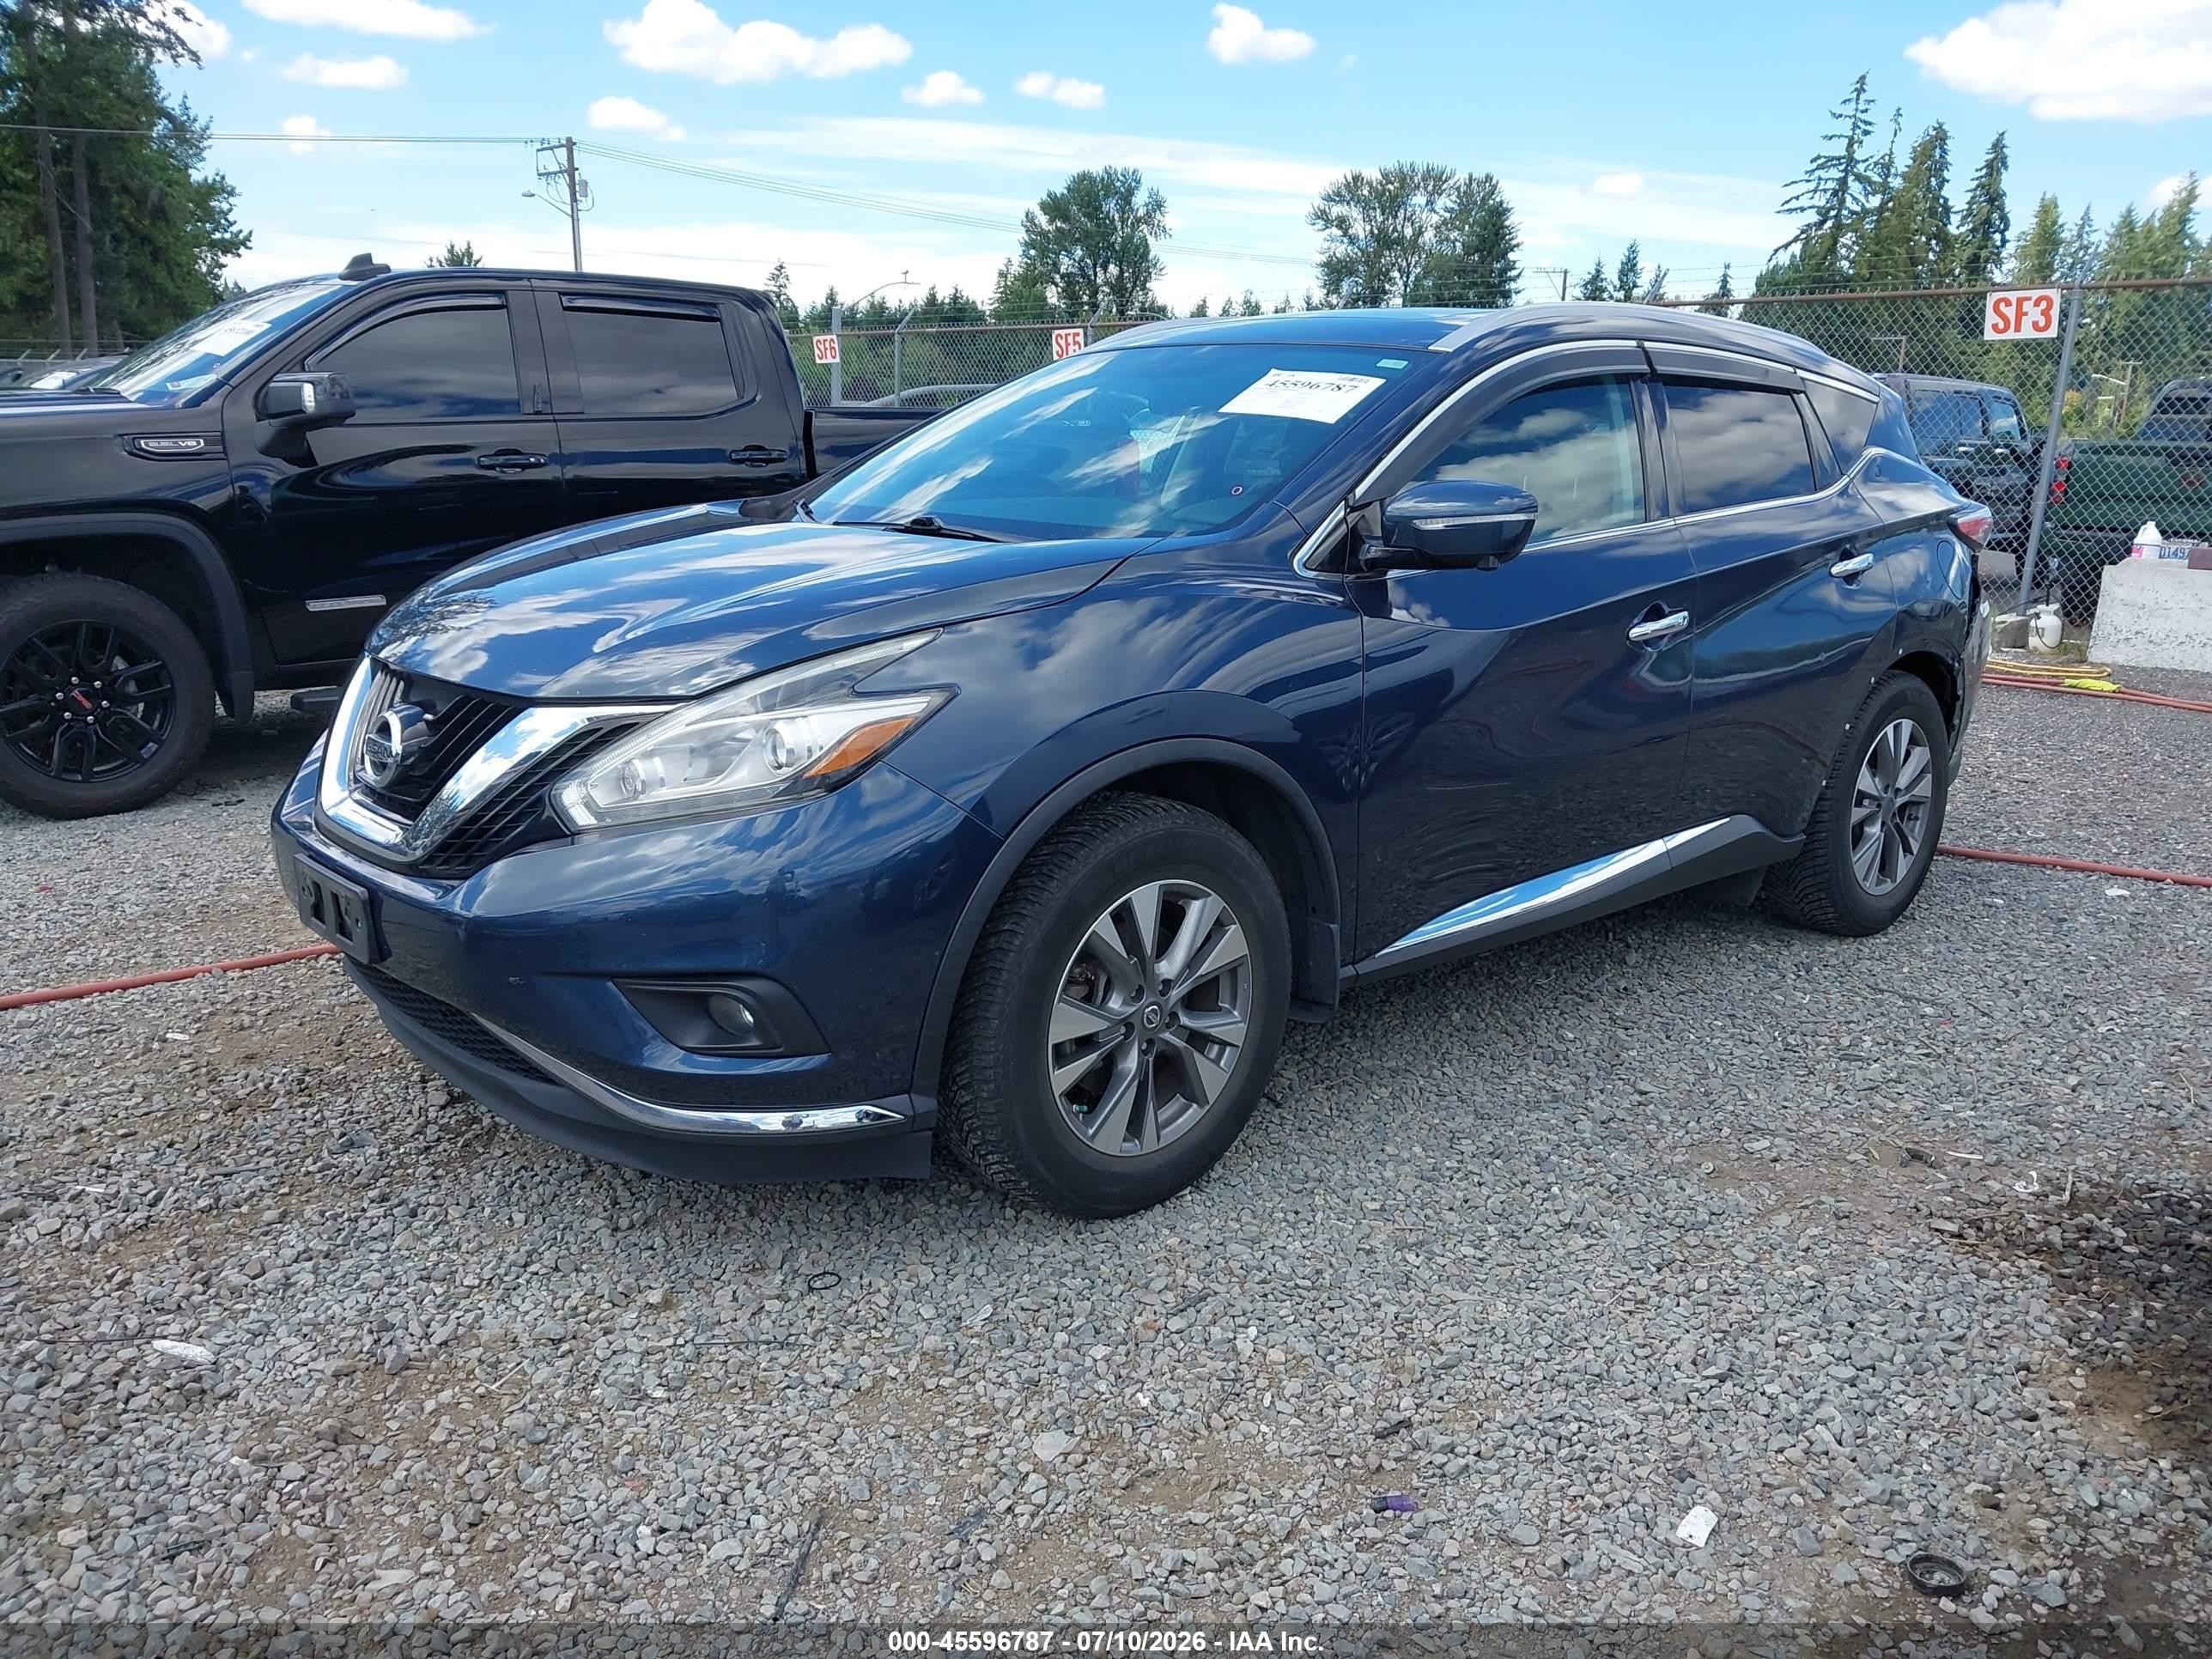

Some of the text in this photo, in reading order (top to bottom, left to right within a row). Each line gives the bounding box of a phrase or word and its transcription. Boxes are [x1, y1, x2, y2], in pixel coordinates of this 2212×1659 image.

[1991, 295, 2054, 335] SF3
[816, 337, 837, 361] SF6
[1054, 331, 1082, 358] SF5
[1266, 379, 1359, 393] 45596787
